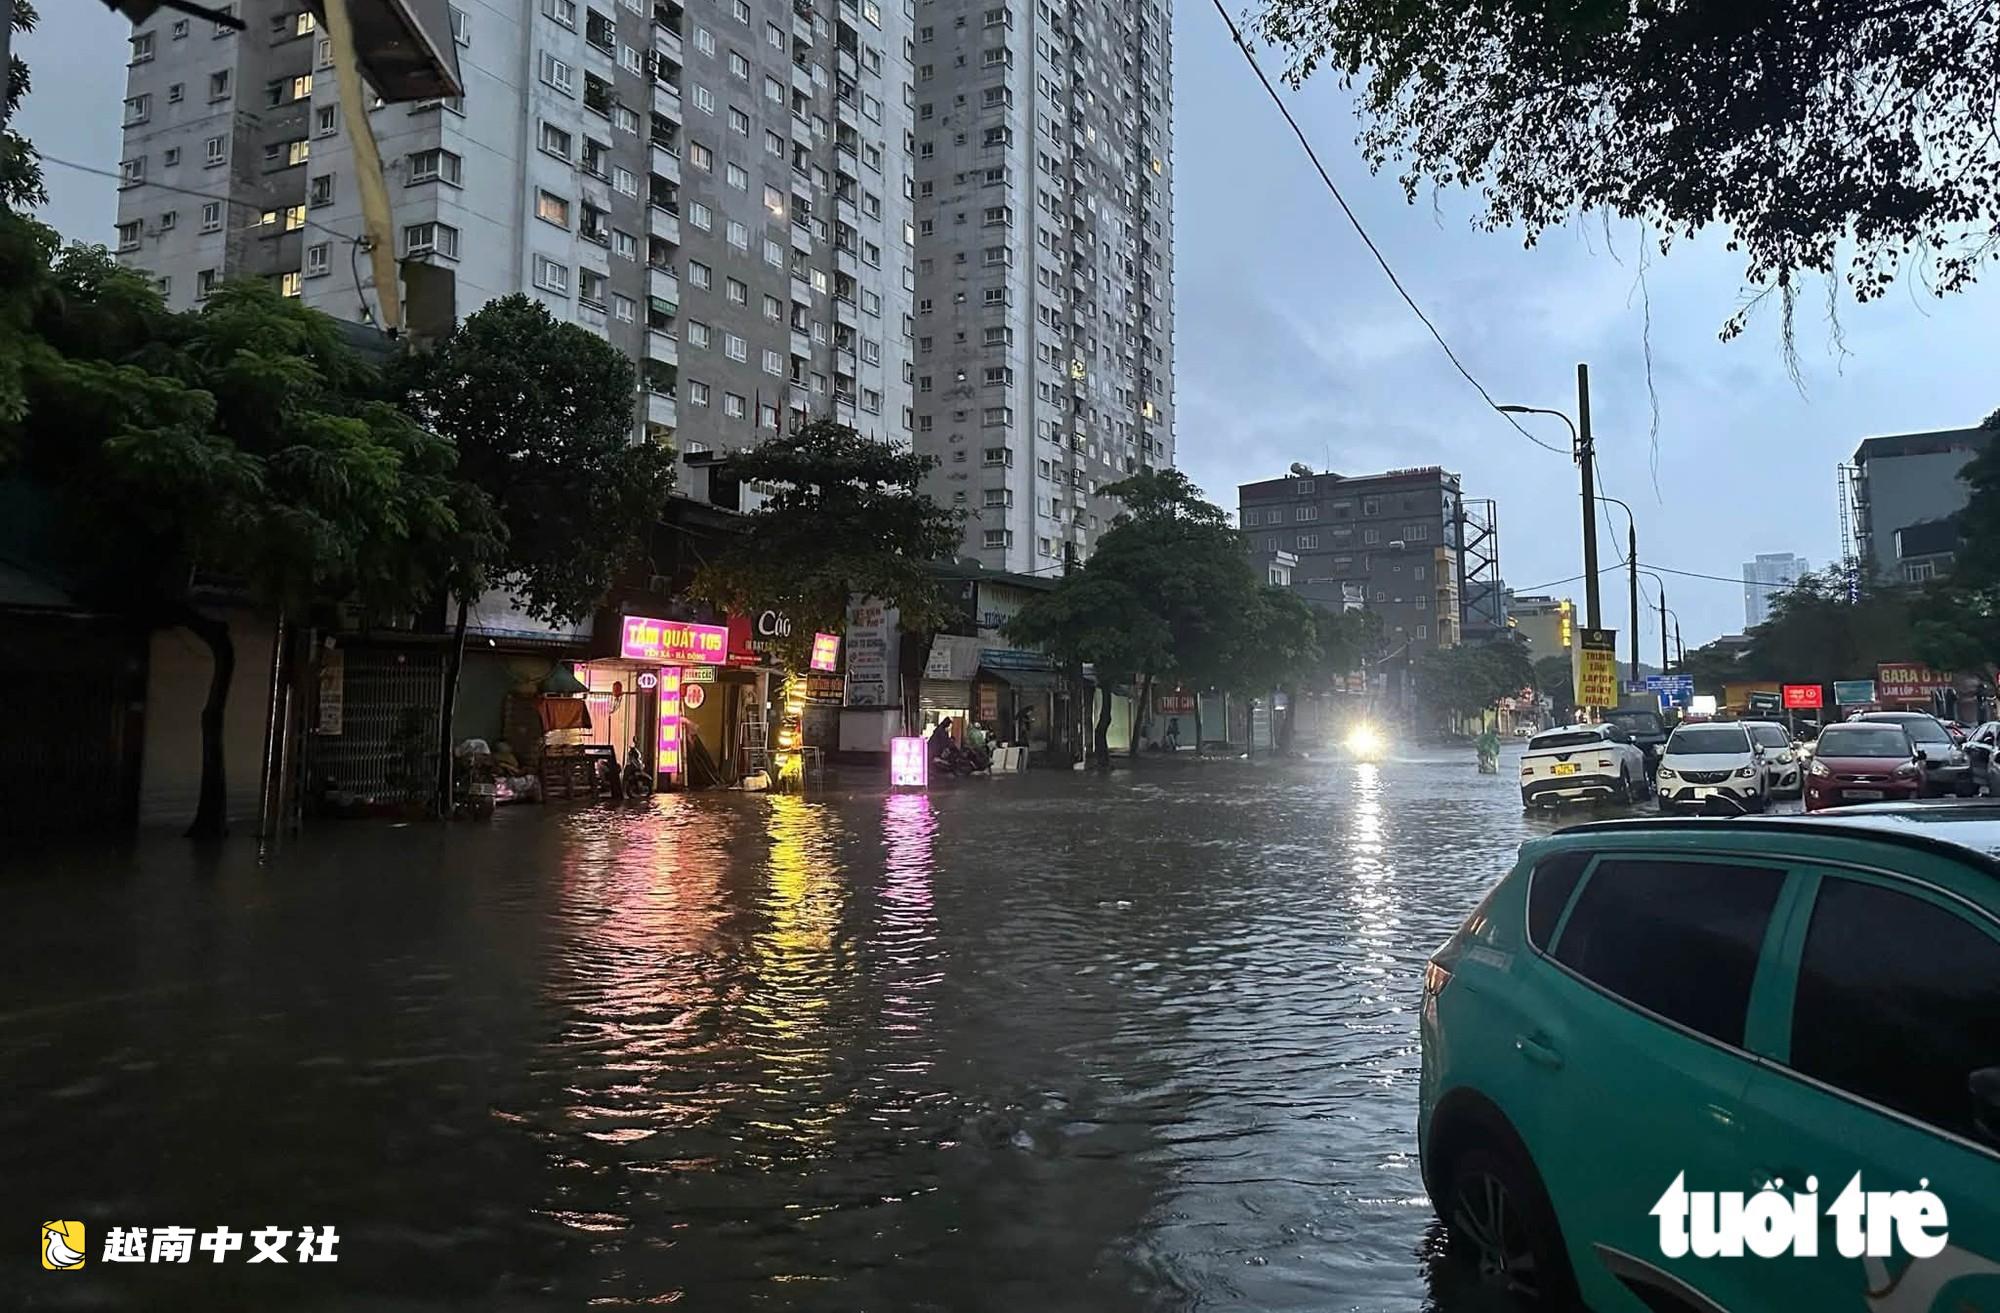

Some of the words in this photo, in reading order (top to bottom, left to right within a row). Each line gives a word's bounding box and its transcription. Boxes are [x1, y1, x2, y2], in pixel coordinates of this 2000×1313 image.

[663, 625, 696, 649] QUẤT
[699, 632, 722, 651] 105
[1582, 674, 1615, 684] LAPTOP
[1881, 669, 1919, 683] GARA
